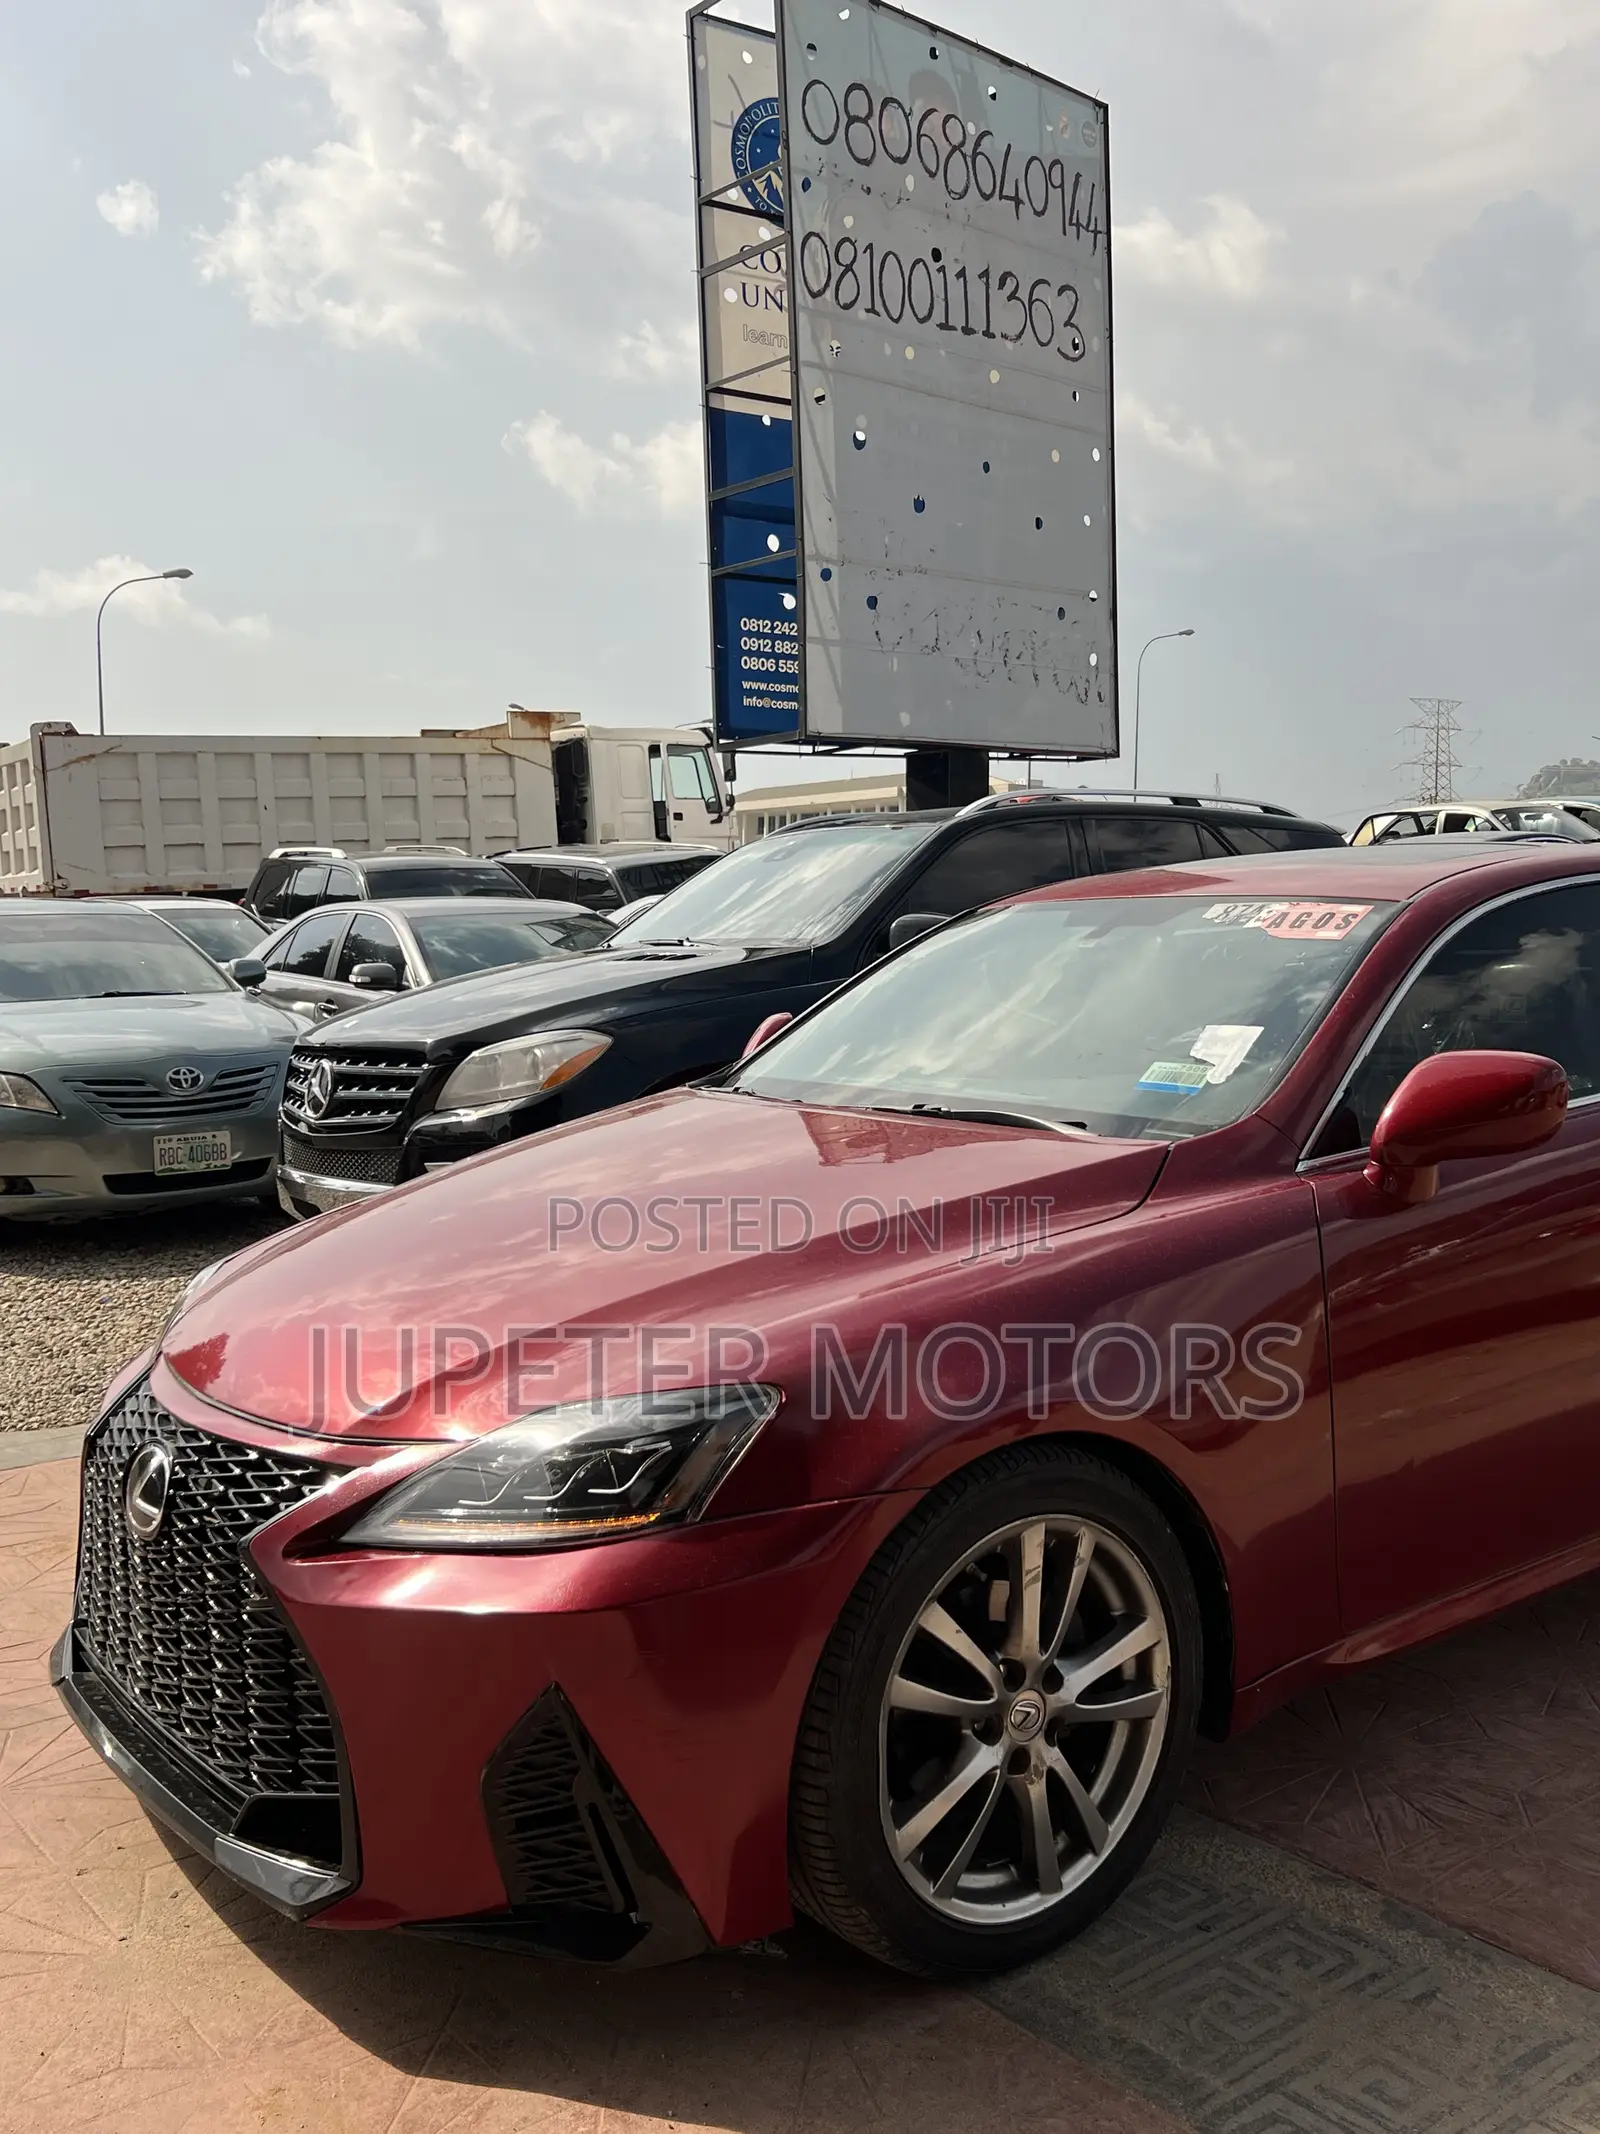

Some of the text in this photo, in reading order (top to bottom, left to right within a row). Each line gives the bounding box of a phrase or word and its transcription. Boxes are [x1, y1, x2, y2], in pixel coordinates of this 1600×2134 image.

[801, 79, 1104, 255] 08068640944
[740, 281, 783, 313] UN
[801, 231, 1086, 362] 08100111363
[743, 323, 788, 349] learn
[740, 617, 798, 636] 0812 242
[740, 636, 799, 655] 0912 882
[740, 656, 776, 672] 0806
[743, 695, 798, 710] info@cosm
